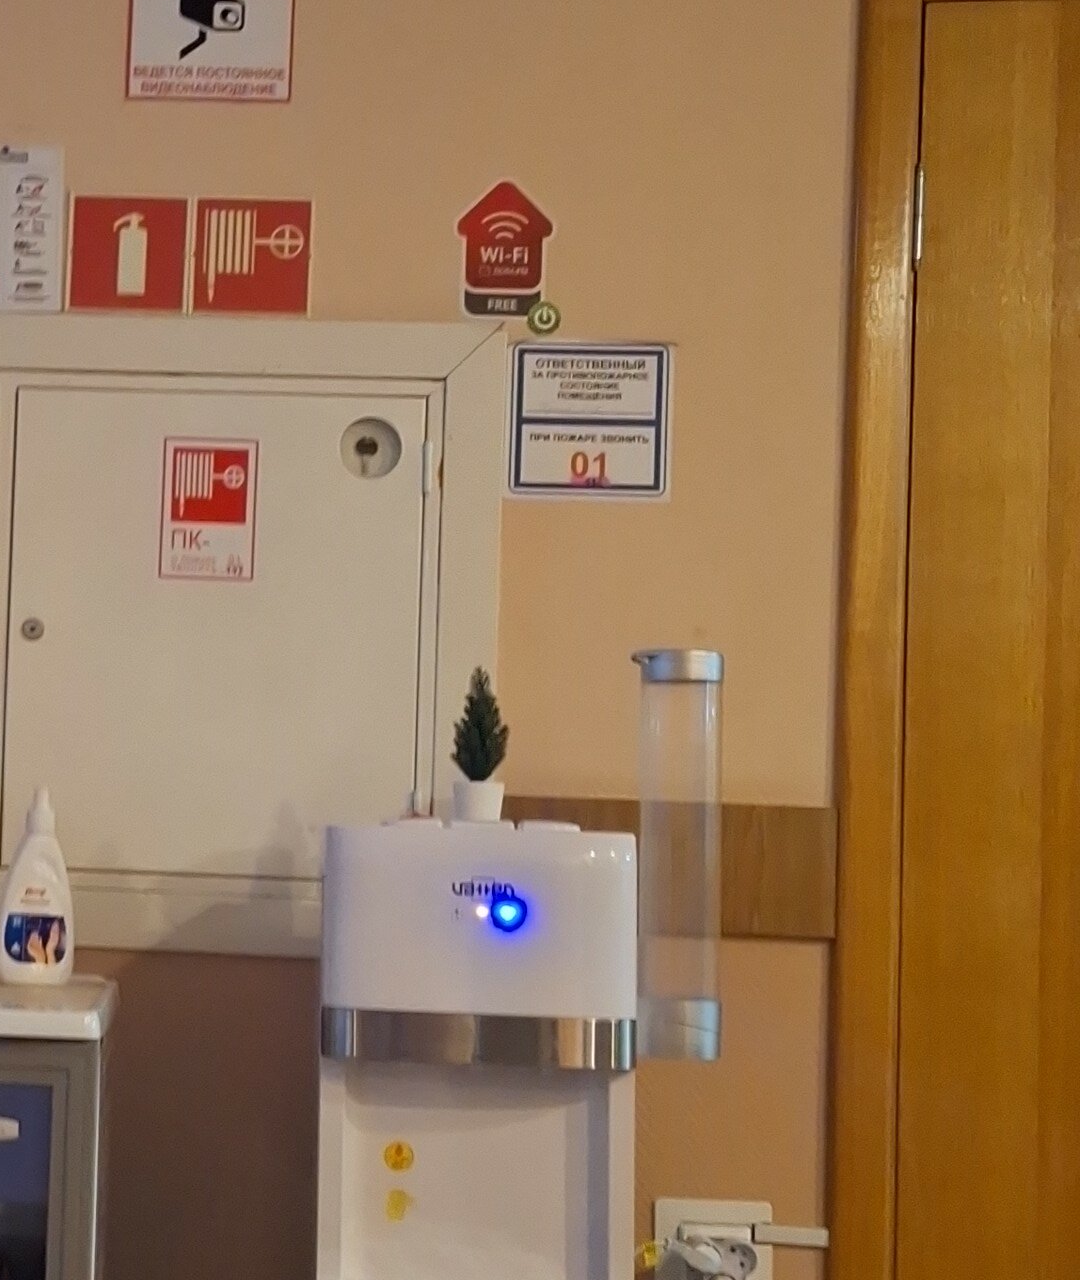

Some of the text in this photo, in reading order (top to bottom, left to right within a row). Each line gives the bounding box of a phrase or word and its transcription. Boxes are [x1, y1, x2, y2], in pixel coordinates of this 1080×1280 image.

[480, 246, 529, 264] Wi-Fi
[487, 298, 519, 312] FREE
[535, 357, 647, 370] ОТВЕТСТВЕННЫЙ
[530, 433, 649, 445] ПРИ ПОЖАРЕ ЗВОНИТЬ
[570, 451, 608, 480] 01
